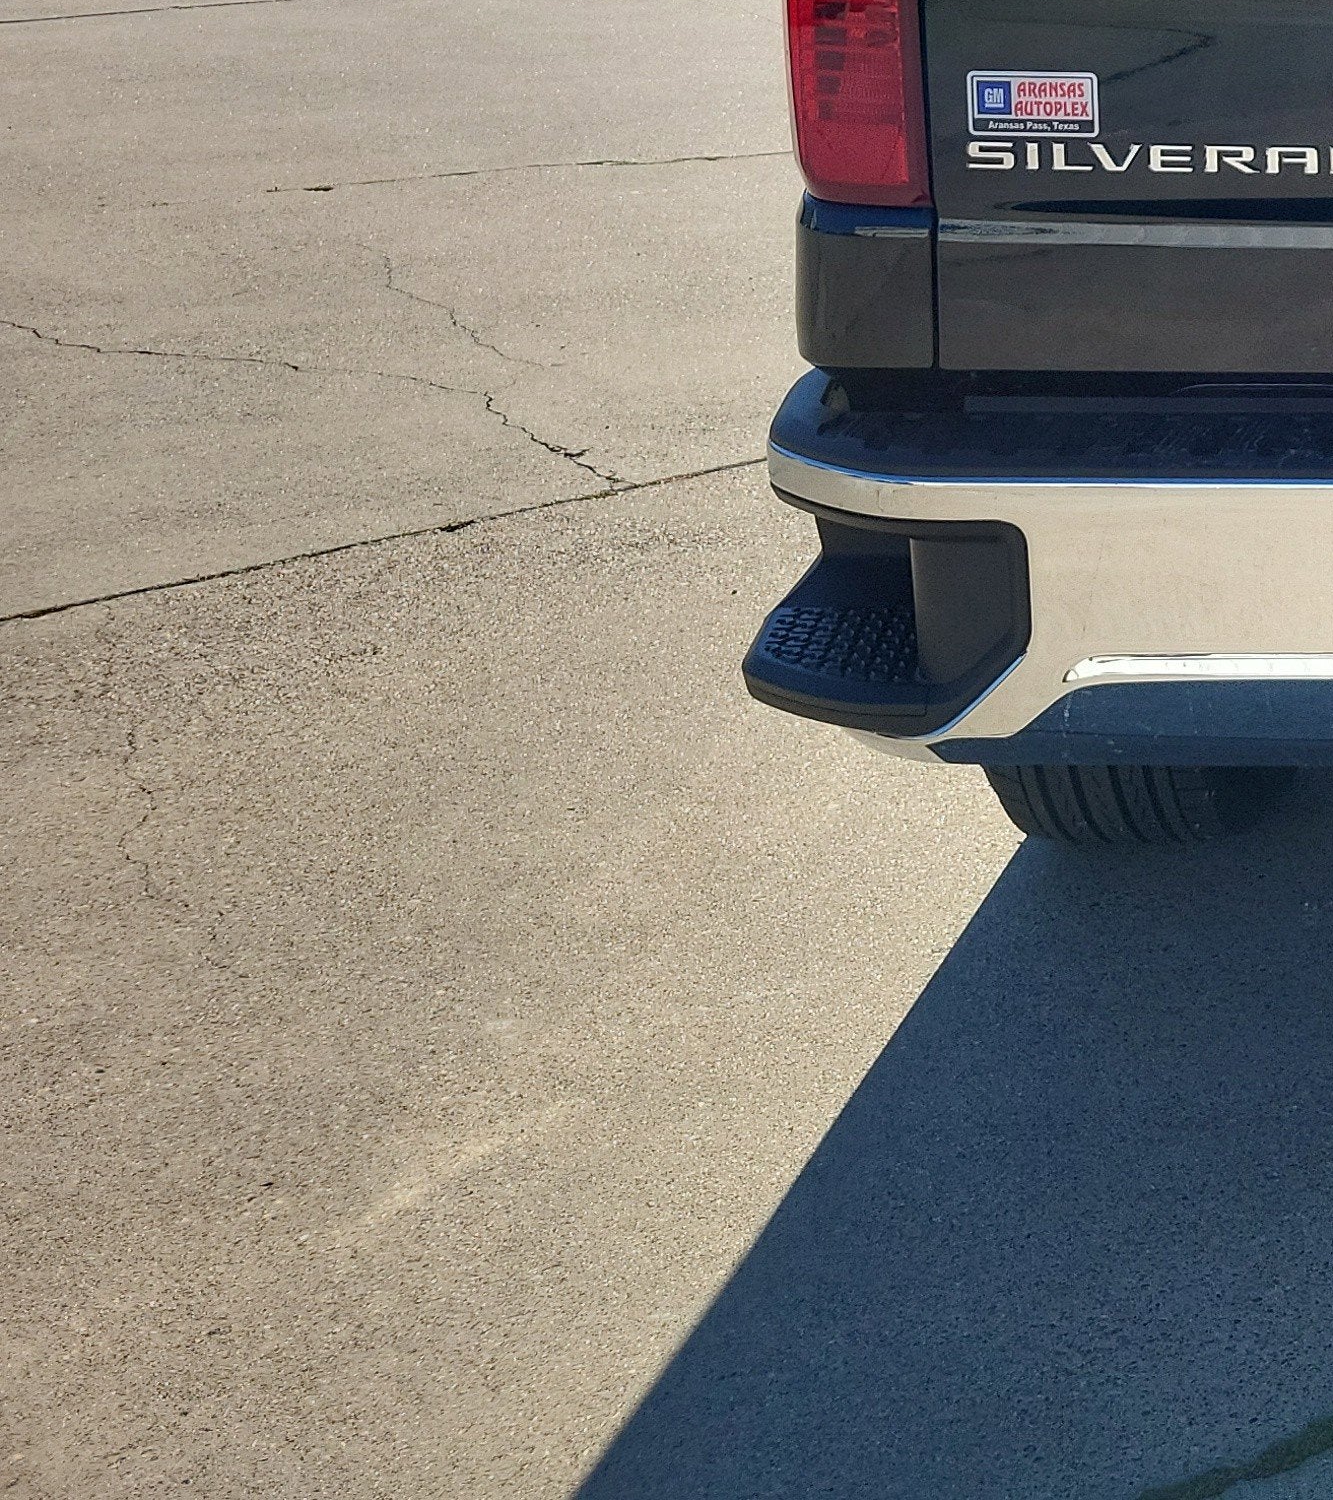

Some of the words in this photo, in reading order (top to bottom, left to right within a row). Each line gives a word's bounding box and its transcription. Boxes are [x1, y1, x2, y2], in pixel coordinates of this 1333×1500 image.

[984, 87, 1004, 104] GM
[1016, 81, 1085, 99] ARANSAS
[1014, 100, 1090, 117] AUTOPLEX
[988, 120, 1024, 130] Aransas
[1026, 121, 1051, 132] Pass,
[1053, 121, 1080, 131] Texas
